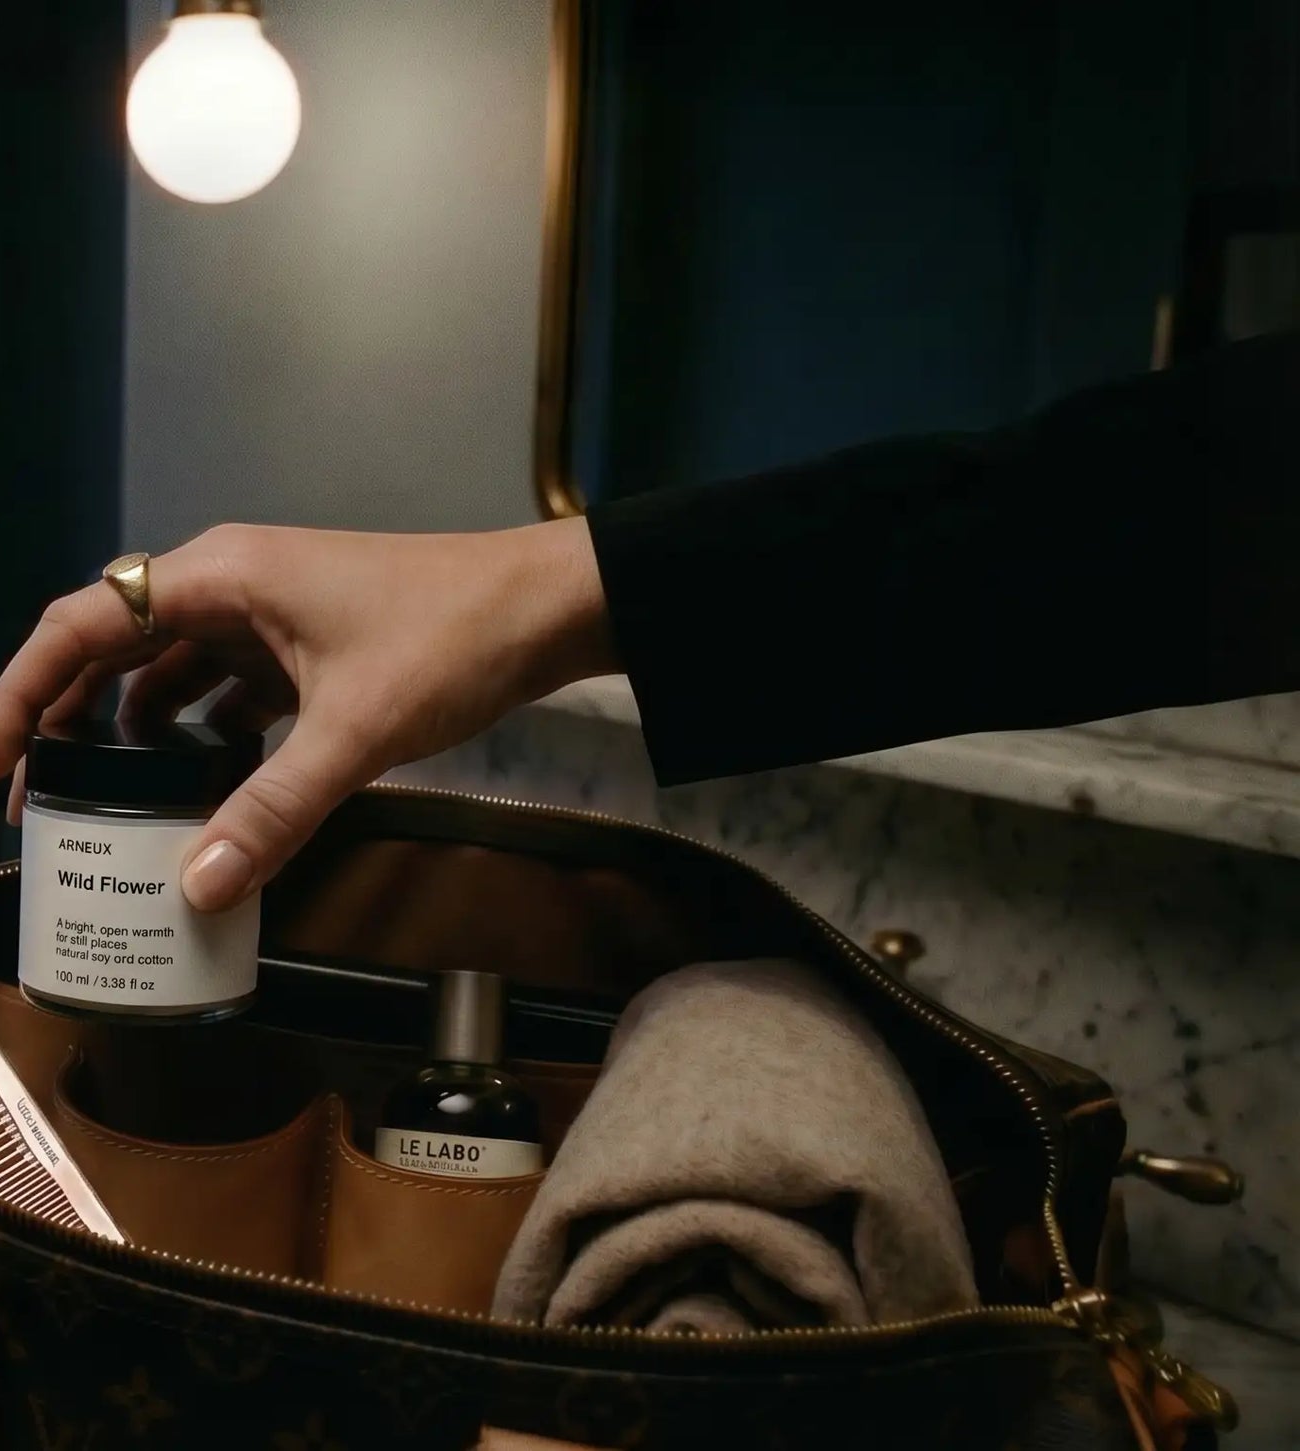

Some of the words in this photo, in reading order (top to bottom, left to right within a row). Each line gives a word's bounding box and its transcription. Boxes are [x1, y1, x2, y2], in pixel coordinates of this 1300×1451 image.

[59, 838, 112, 855] ARNEUX
[58, 870, 93, 891] Wild
[101, 877, 165, 894] Flower
[57, 918, 63, 928] A
[65, 919, 97, 935] bright,
[101, 927, 128, 937] open
[132, 927, 174, 937] warmth
[56, 932, 67, 943] for
[71, 934, 87, 946] still
[91, 939, 127, 950] places
[56, 948, 89, 960] natural
[92, 954, 110, 965] soy
[114, 954, 134, 964] ord
[138, 955, 173, 965] cotton
[55, 970, 72, 983] 100
[76, 974, 89, 985] ml
[101, 977, 125, 988] 3.38
[130, 979, 137, 989] fl
[141, 981, 155, 990] oz
[400, 1138, 420, 1155] LE
[427, 1141, 480, 1162] LABO
